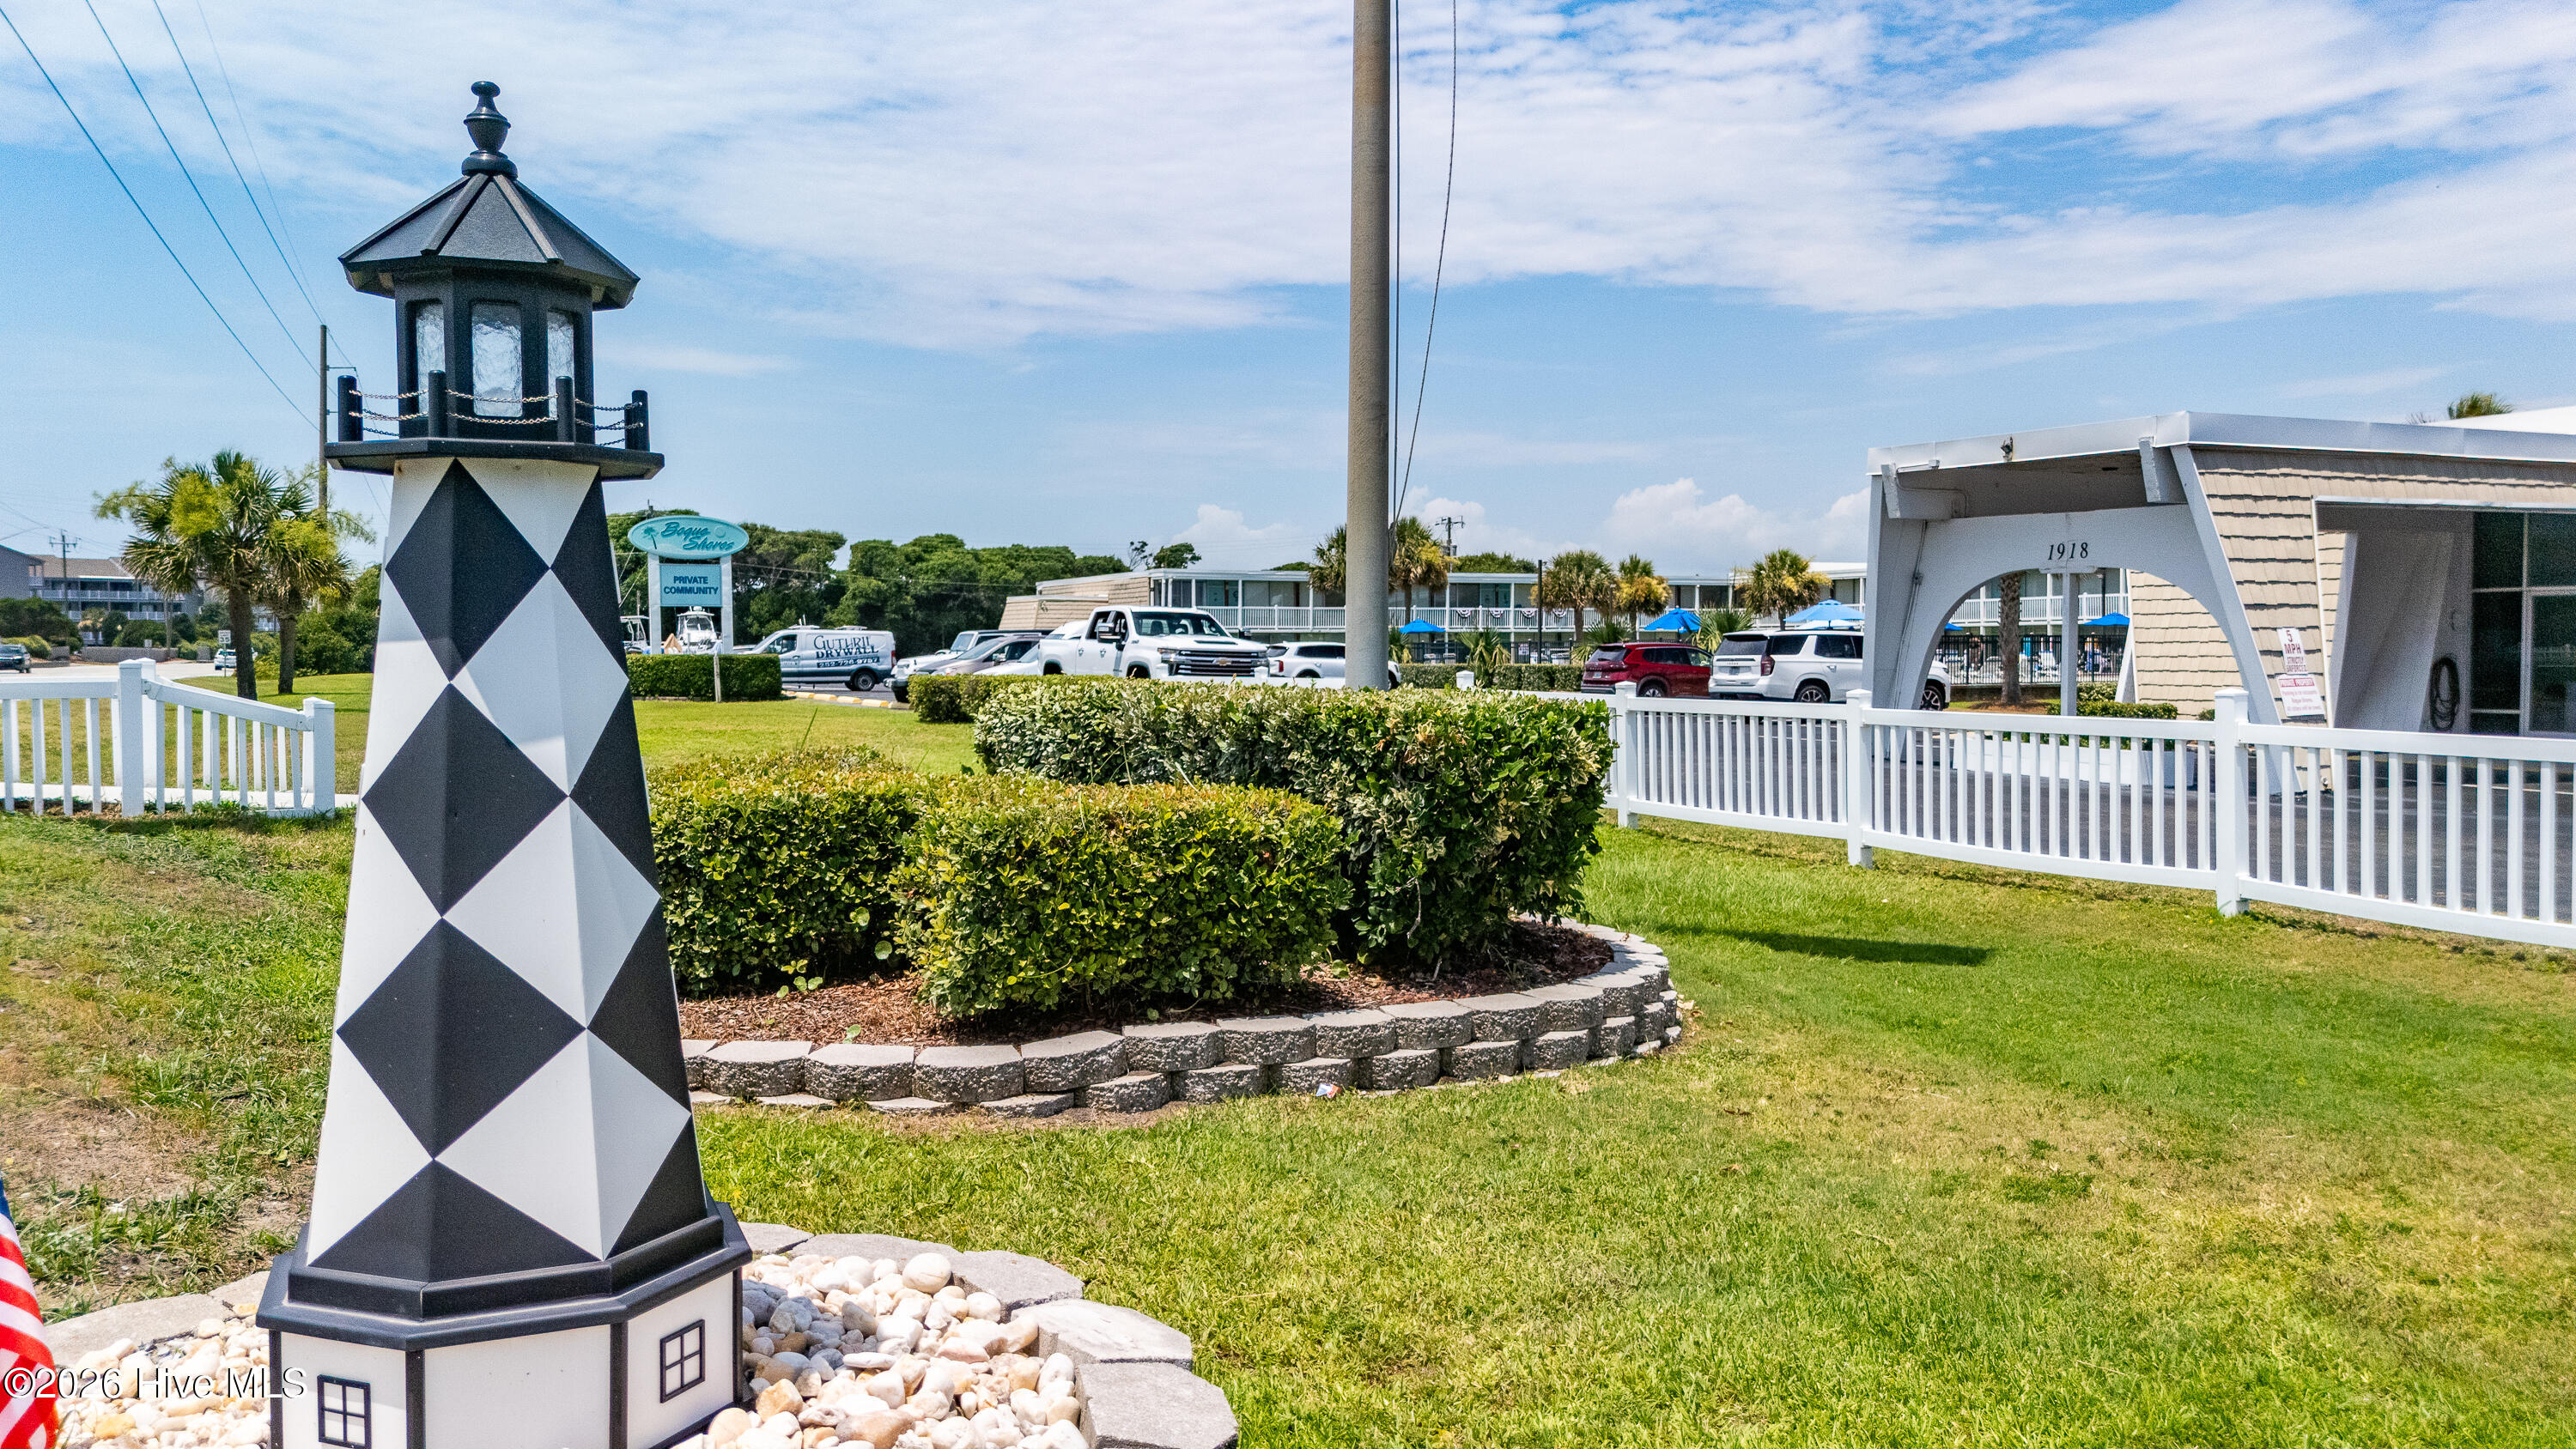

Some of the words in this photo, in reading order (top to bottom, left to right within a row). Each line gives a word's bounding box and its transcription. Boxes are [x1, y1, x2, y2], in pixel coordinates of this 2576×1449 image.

[660, 521, 711, 542] Bogue
[682, 536, 735, 551] Shores
[2047, 542, 2088, 560] 1918
[673, 576, 708, 585] PRIVATE
[663, 586, 719, 595] COMMUNITY
[2286, 630, 2293, 642] 5
[815, 645, 879, 659] DRYWALL
[2284, 643, 2302, 654] MPH
